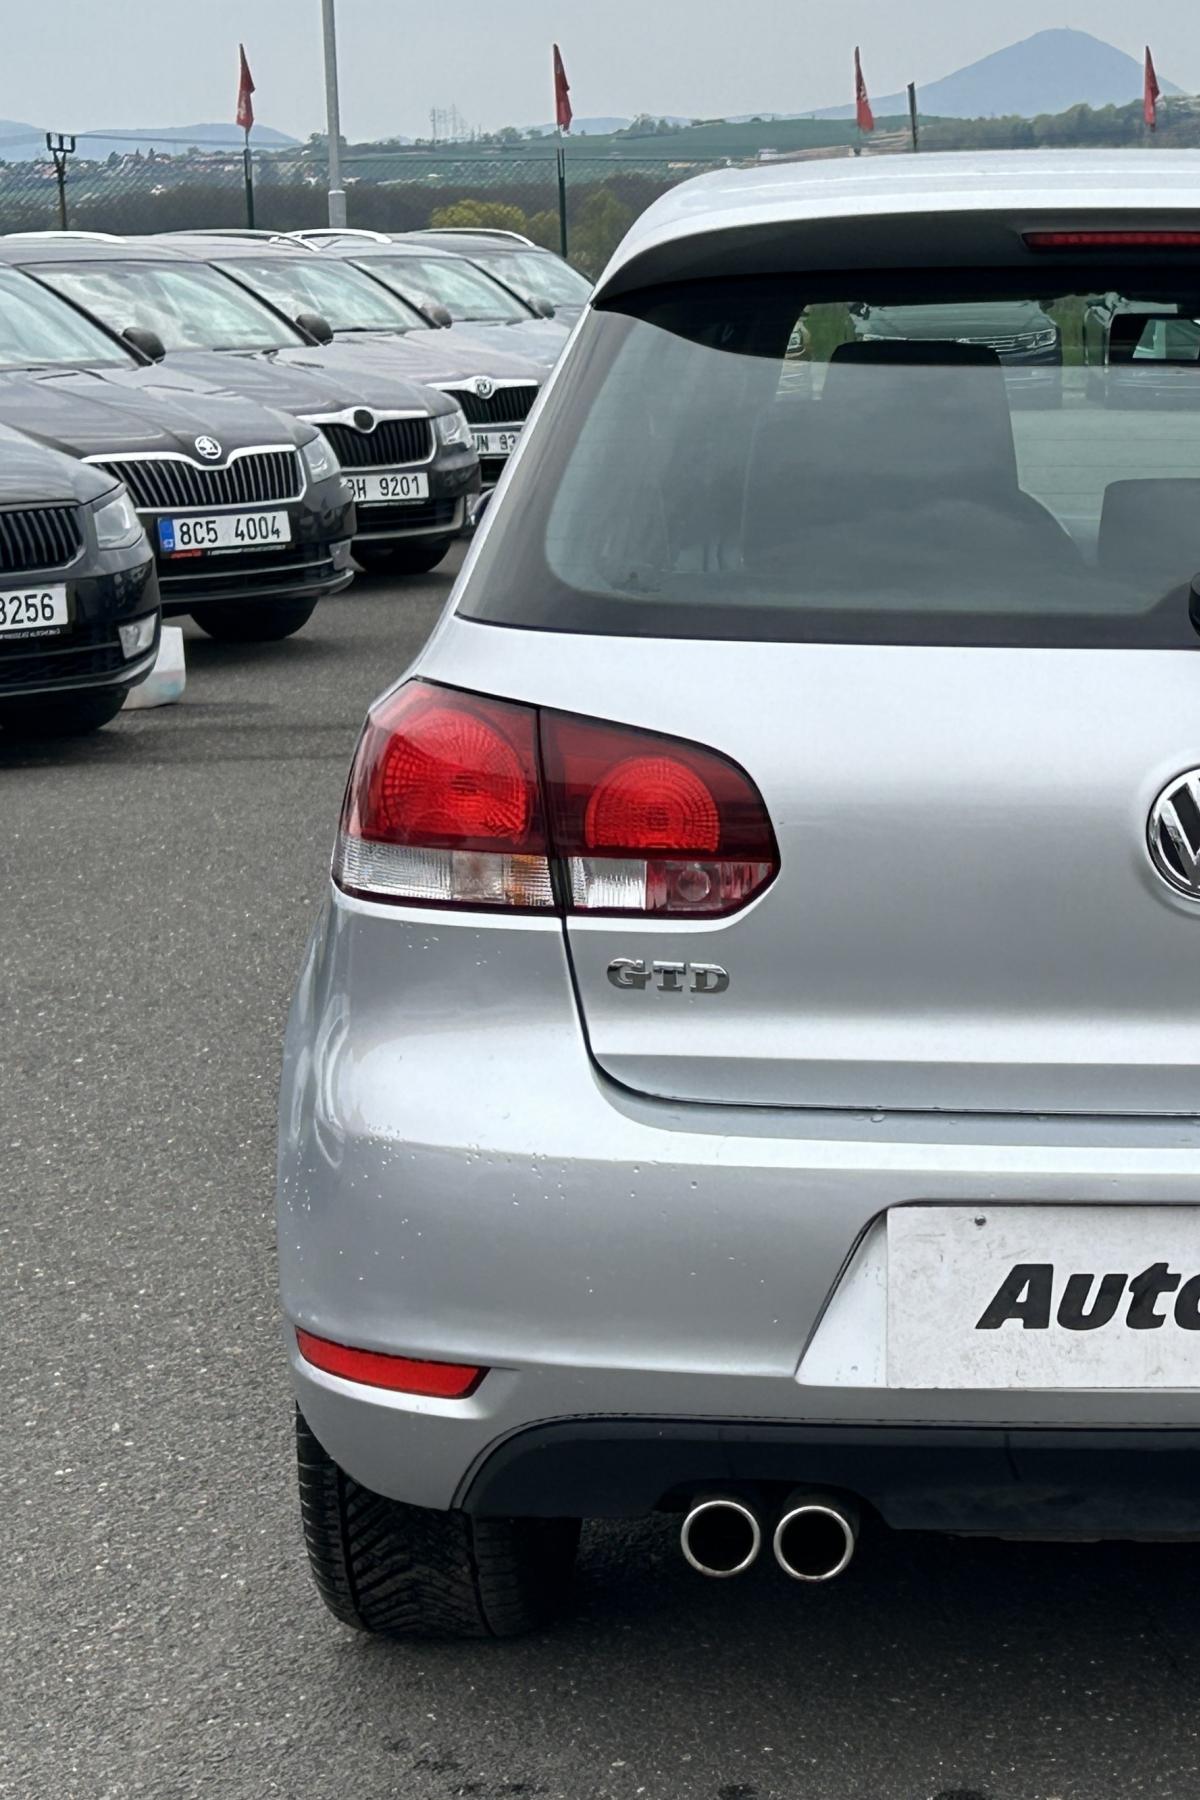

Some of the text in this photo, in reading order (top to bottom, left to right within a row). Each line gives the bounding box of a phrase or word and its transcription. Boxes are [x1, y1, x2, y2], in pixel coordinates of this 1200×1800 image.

[379, 475, 420, 497] 9201
[179, 515, 281, 546] 8C5 4004
[607, 958, 730, 993] GTD
